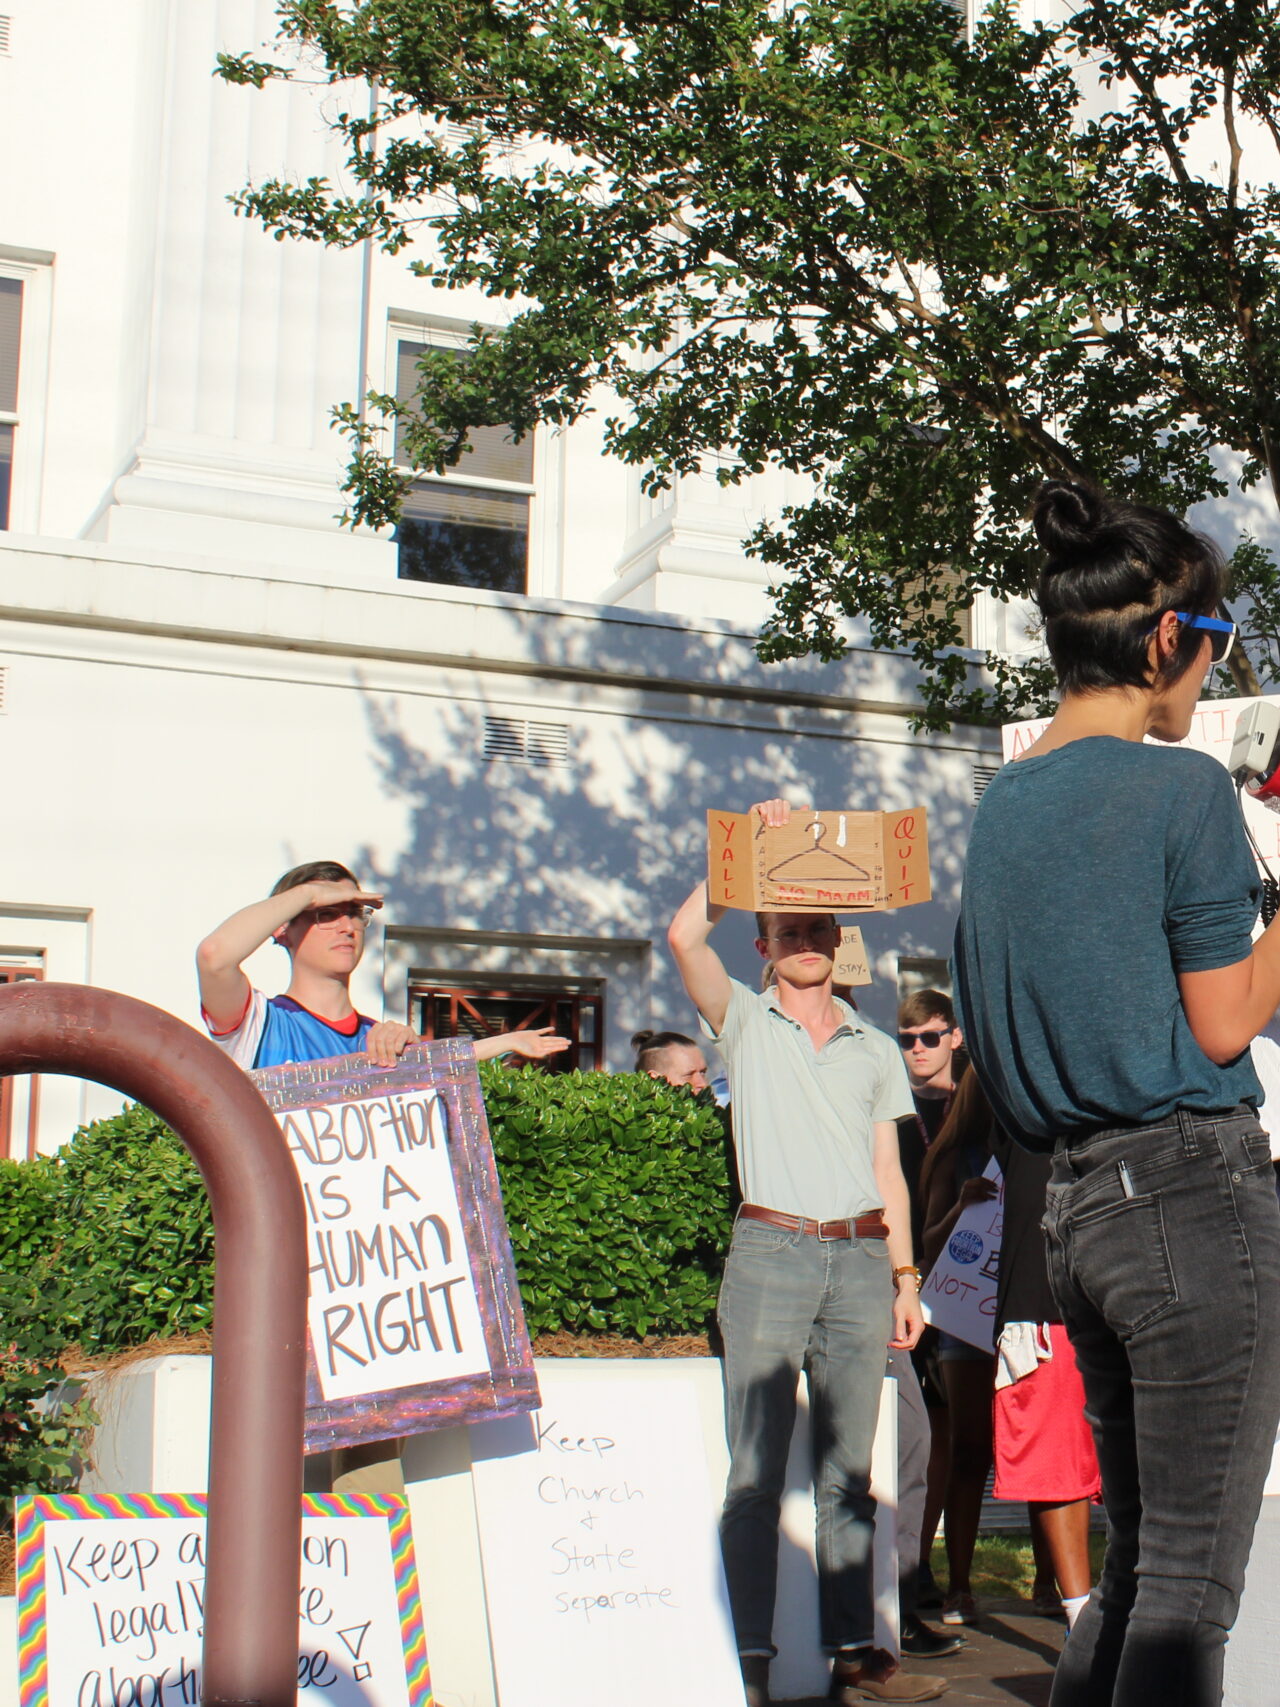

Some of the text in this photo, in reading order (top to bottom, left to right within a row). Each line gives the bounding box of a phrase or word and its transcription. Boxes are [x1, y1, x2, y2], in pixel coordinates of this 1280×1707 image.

[303, 1164, 422, 1225] IS A
[928, 1271, 979, 1302] NOT
[322, 1276, 467, 1377] RIGHT
[534, 1410, 616, 1459] Keep
[537, 1475, 645, 1504] Church
[53, 1531, 160, 1597] Keep
[551, 1537, 639, 1576] State
